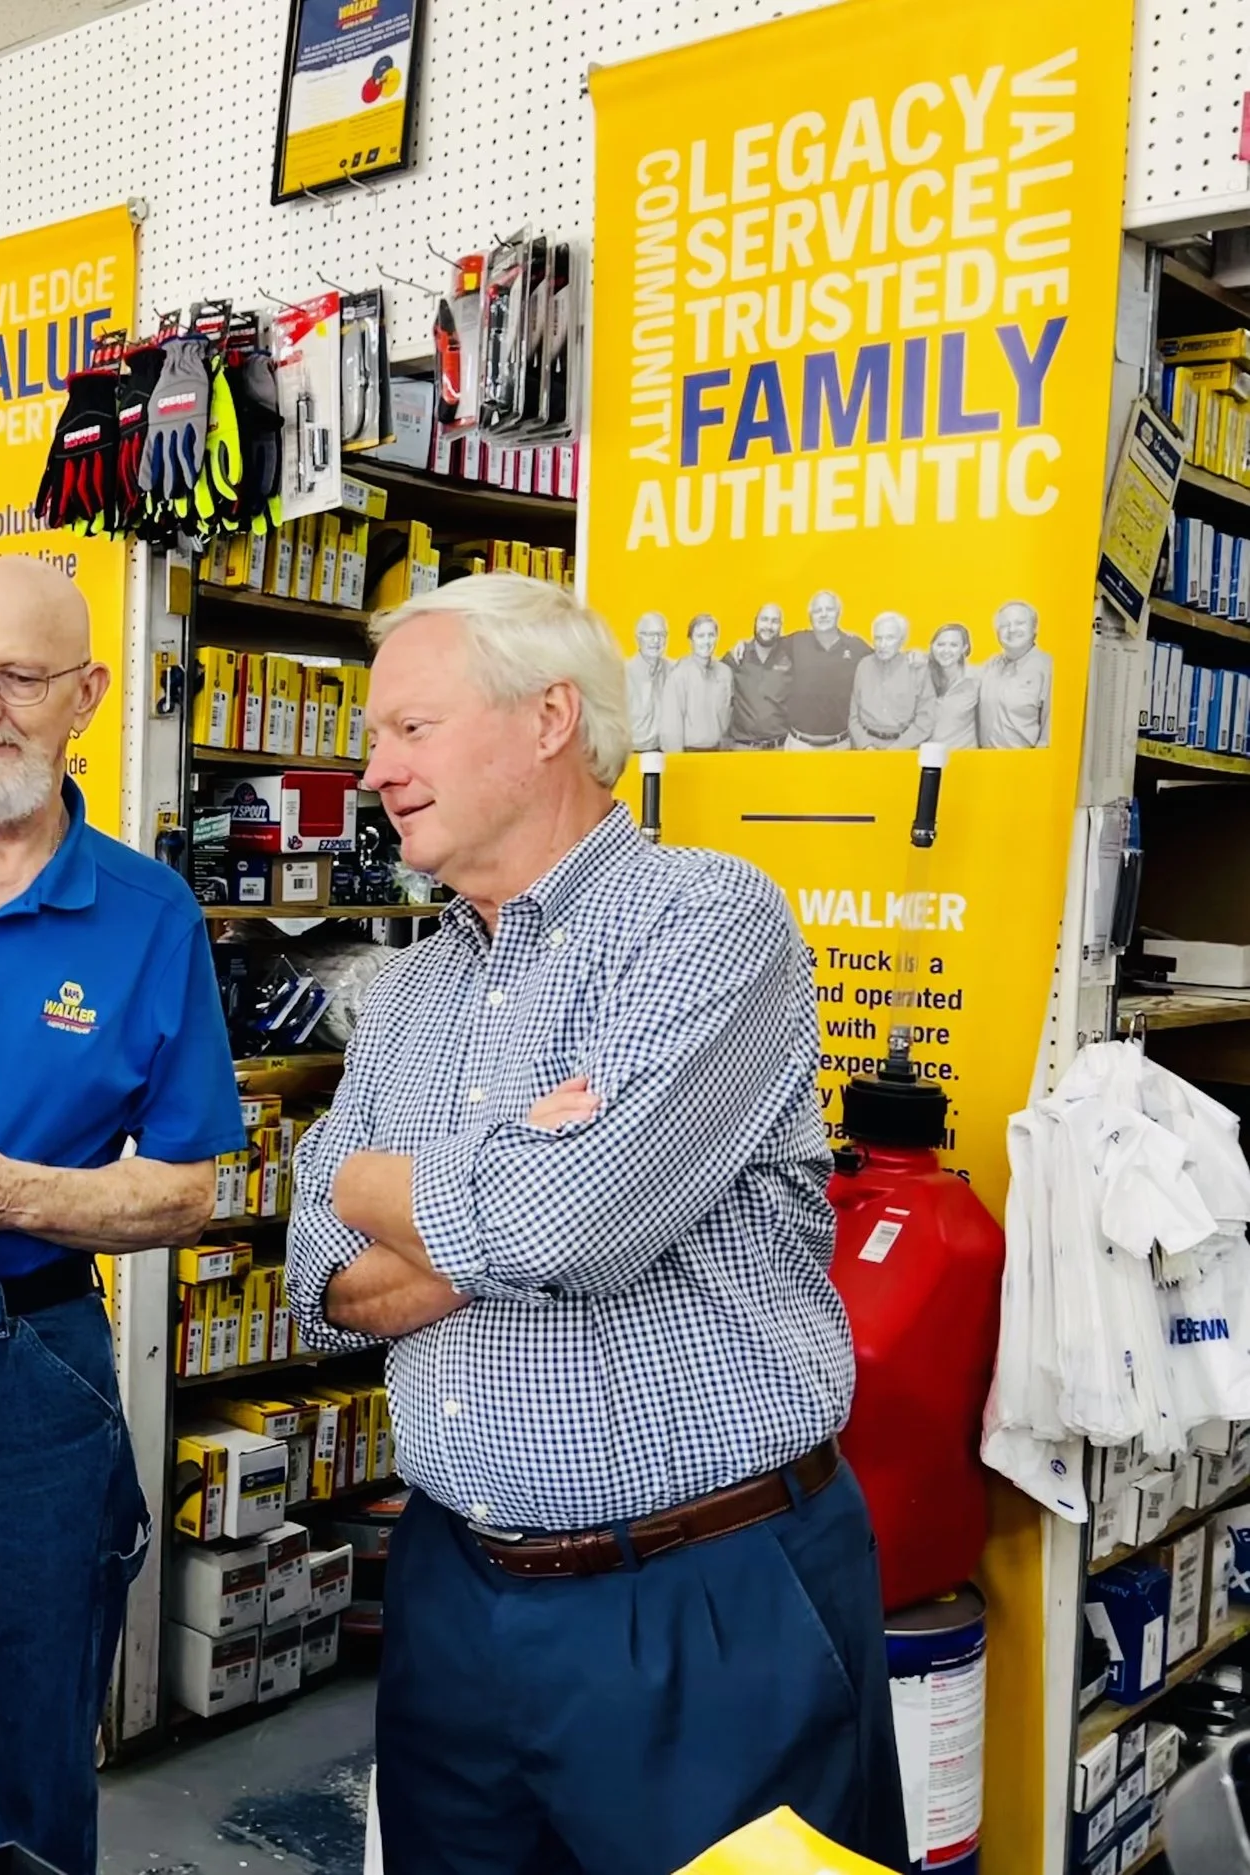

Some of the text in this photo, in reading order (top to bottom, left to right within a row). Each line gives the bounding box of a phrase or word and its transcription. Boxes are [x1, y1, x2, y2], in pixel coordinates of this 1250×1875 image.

[687, 66, 1005, 213] LEGACY
[1002, 47, 1078, 315] VALUE
[685, 157, 1000, 289] SERVICE
[630, 148, 681, 465] COMMUNITY
[685, 248, 998, 364] TRUSTED
[680, 315, 1068, 467] FAMILY
[625, 434, 1062, 551] AUTHENTIC
[798, 888, 968, 932] WALKER
[826, 947, 892, 972] Truck
[929, 957, 943, 974] a
[43, 999, 97, 1023] WALKER
[816, 982, 845, 1003] nd
[826, 1018, 950, 1045] with ore
[820, 1053, 960, 1081] expernce.
